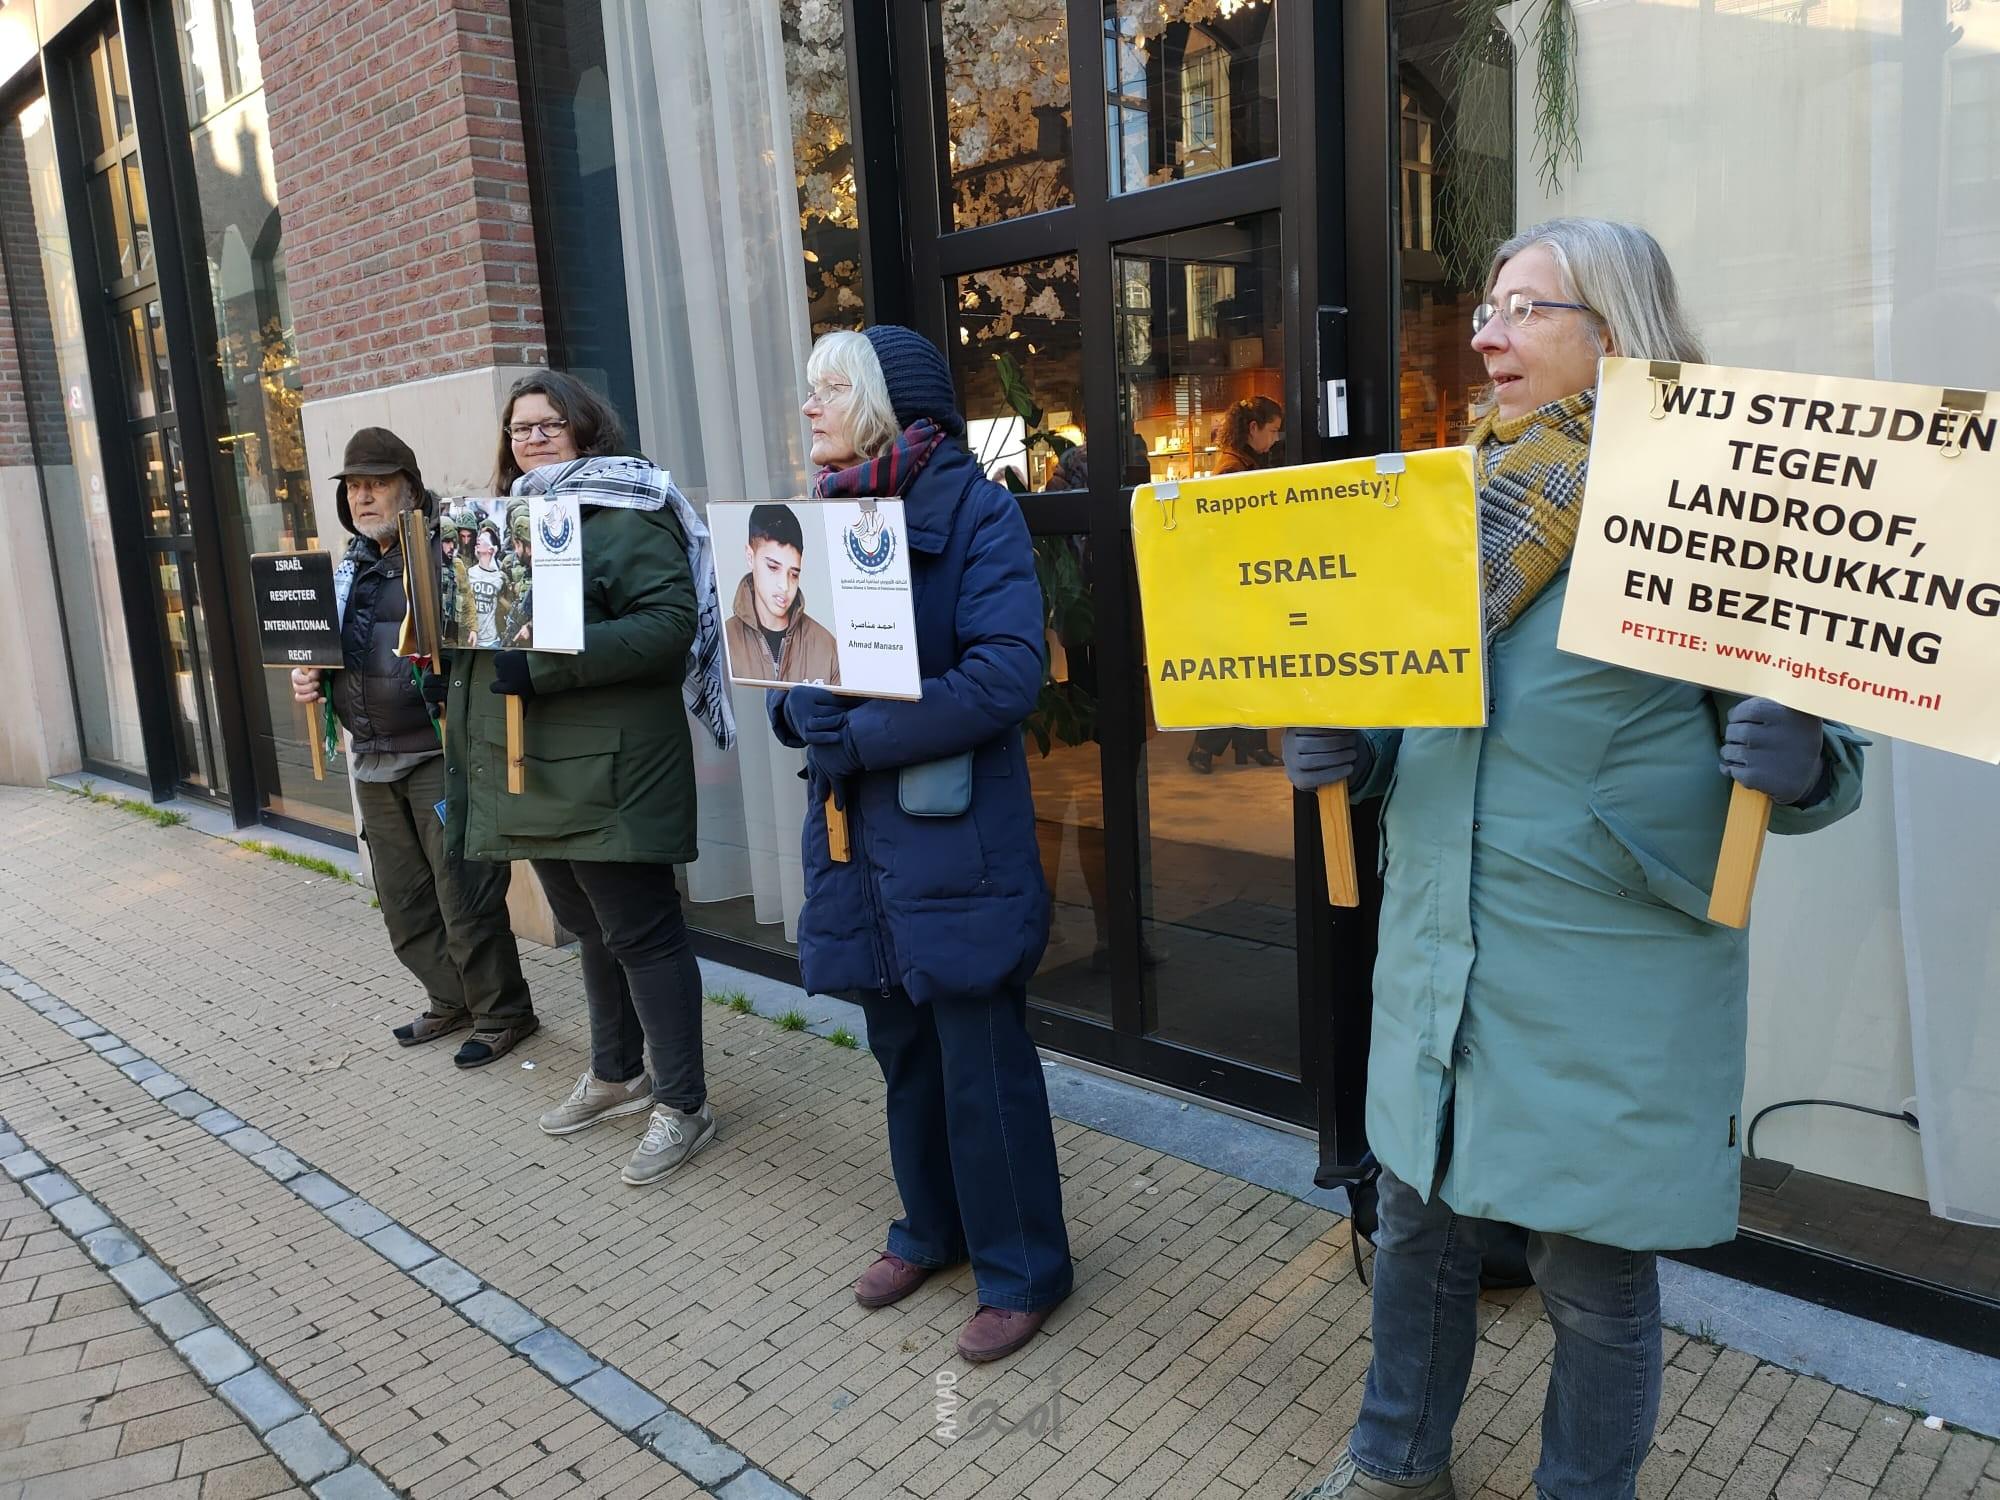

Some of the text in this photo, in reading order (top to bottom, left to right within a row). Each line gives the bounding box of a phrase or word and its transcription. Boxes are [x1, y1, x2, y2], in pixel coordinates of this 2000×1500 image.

[1662, 384, 1998, 451] WIJ STRIJDEN
[1728, 440, 1878, 490] TEGEN
[1196, 489, 1278, 515] Rapport
[1667, 479, 1928, 558] LANDROOF,
[275, 557, 303, 571] ISRAËL
[1238, 554, 1357, 586] ISRAEL
[1604, 515, 2000, 616] ONDERDRUKKING
[269, 589, 316, 601] RESPECTEER
[264, 620, 330, 631] INTERNATIONAAL
[1289, 612, 1308, 627] =
[1624, 570, 1943, 665] EN BEZETTING
[288, 650, 312, 661] RECHT
[848, 640, 904, 651] Ahmad Manasra
[1160, 648, 1471, 682] APARTHEIDSSTAAT
[1621, 620, 1942, 711] PETITIE: www.rightsforum.nl
